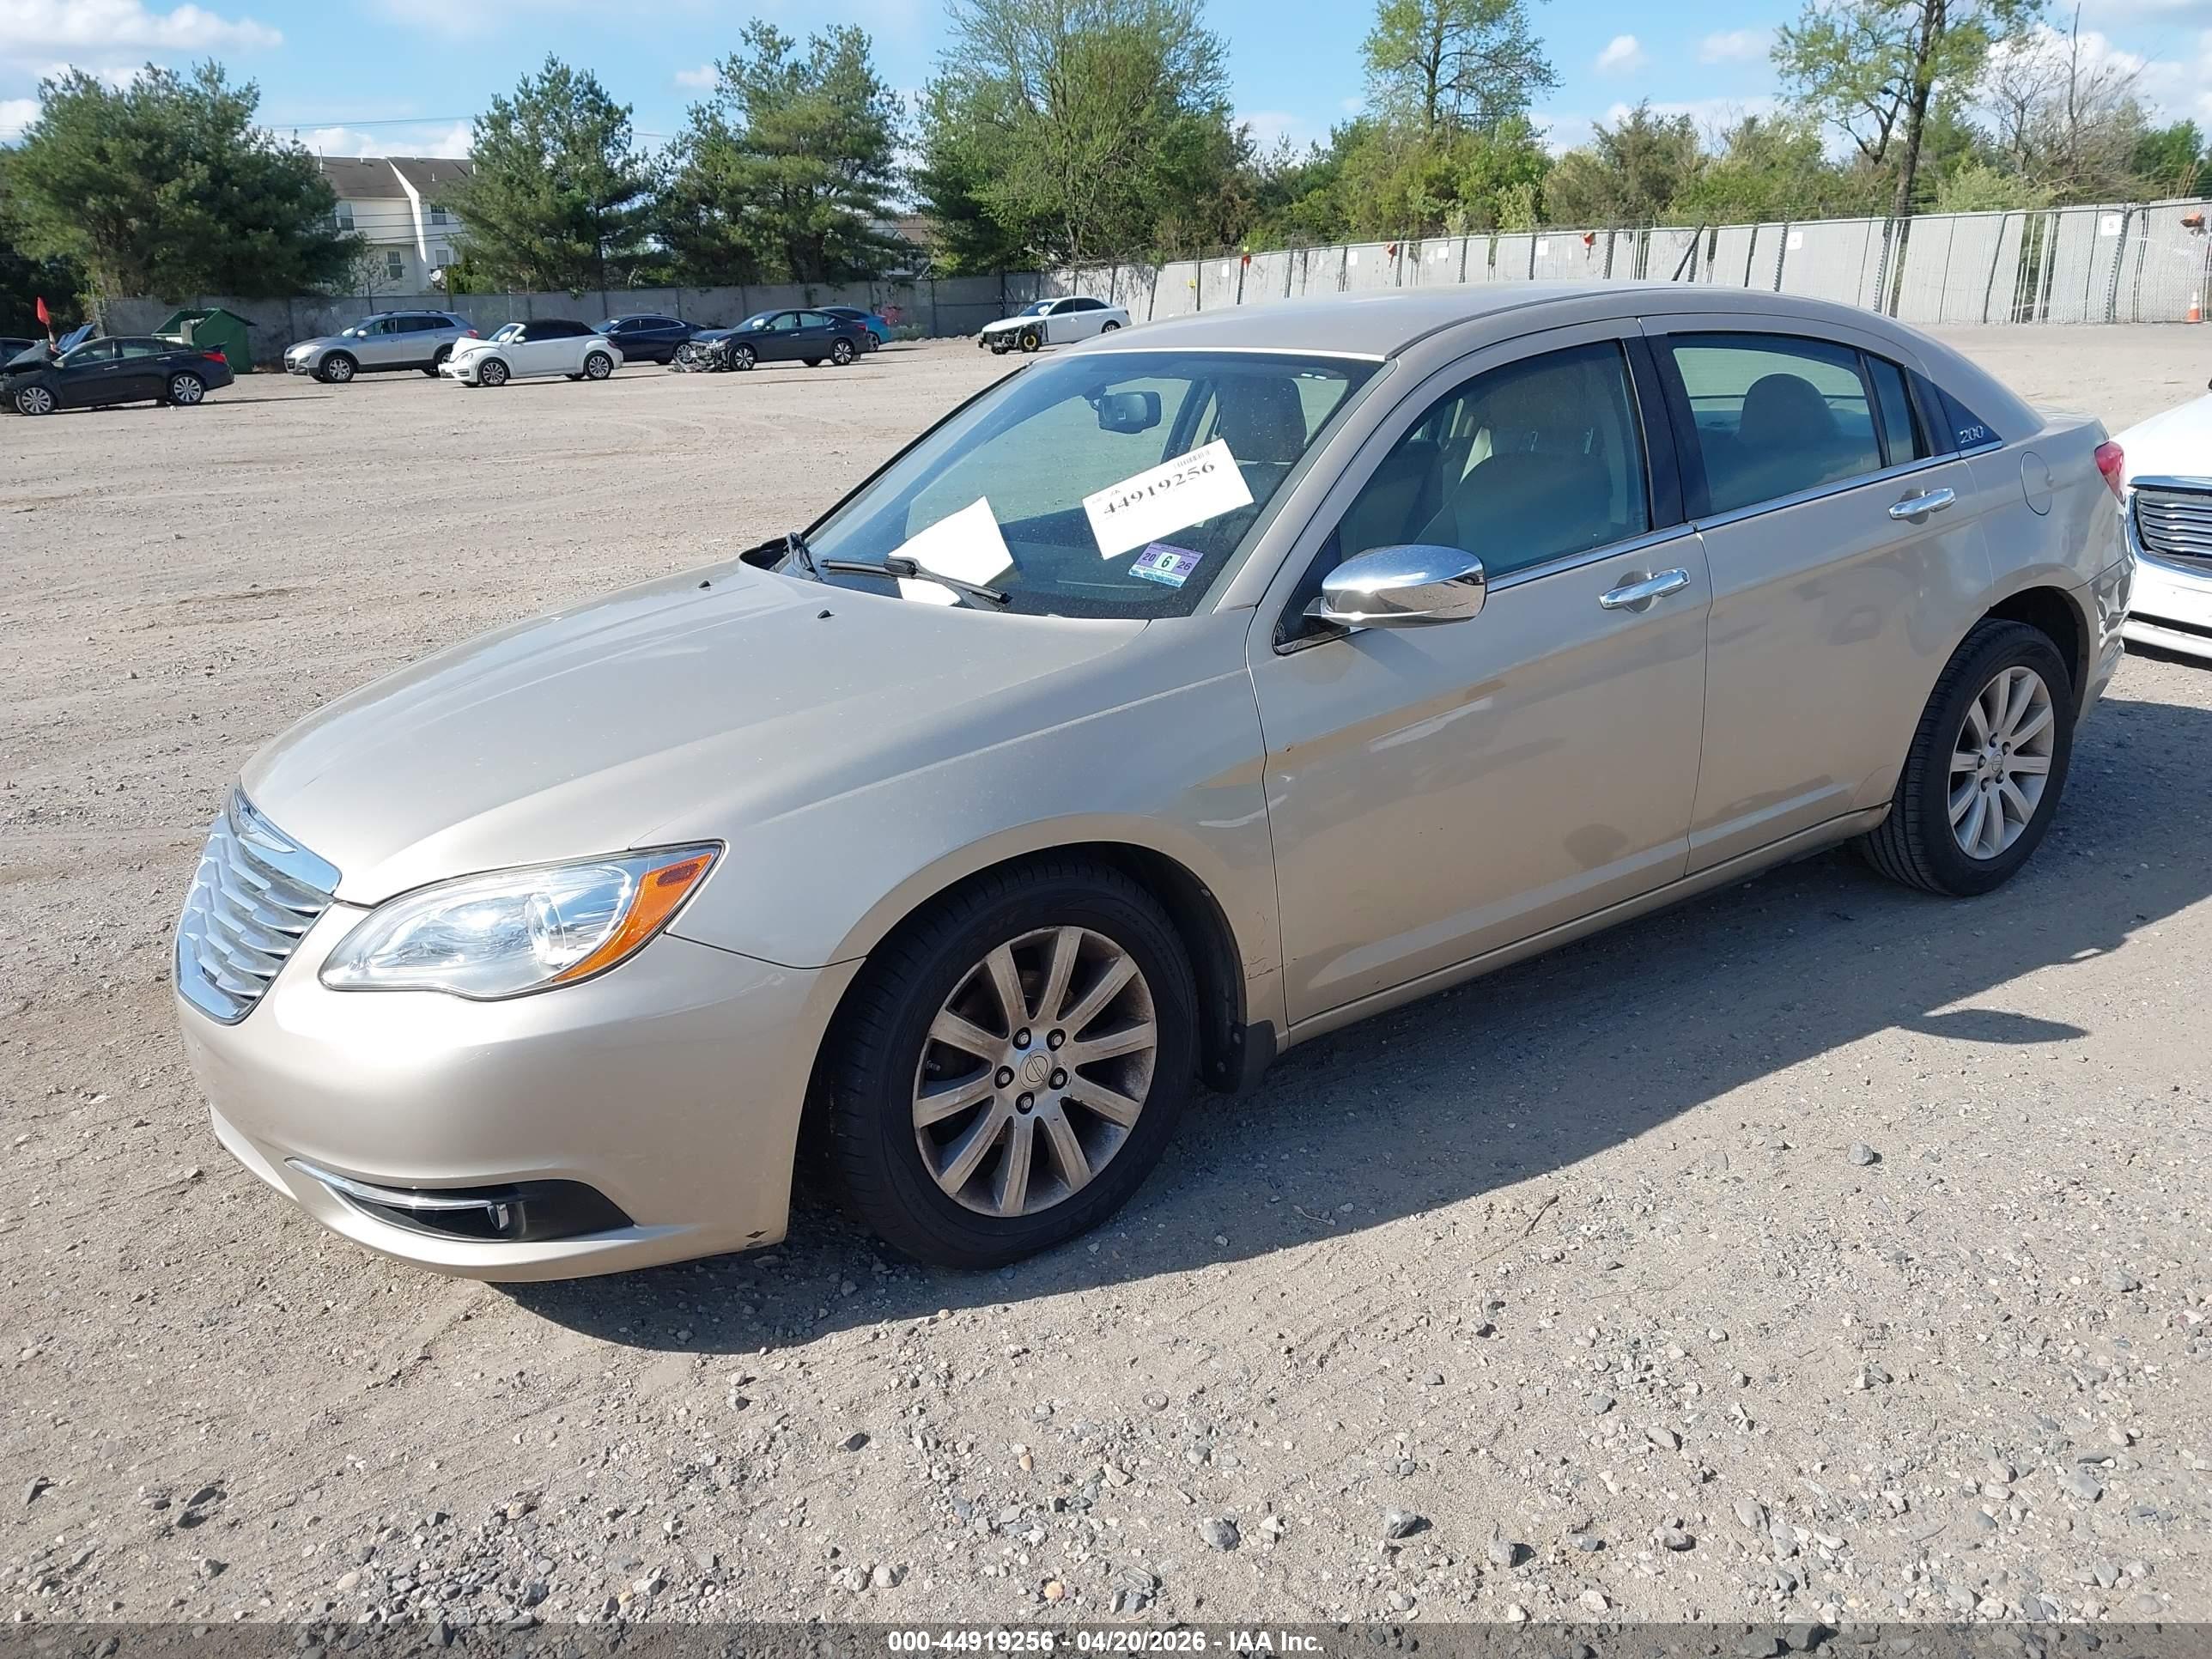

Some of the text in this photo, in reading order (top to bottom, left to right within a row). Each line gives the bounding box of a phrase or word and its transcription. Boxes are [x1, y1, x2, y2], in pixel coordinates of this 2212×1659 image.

[1959, 425, 1984, 444] 200
[1103, 459, 1215, 514] 44919256
[1142, 552, 1193, 571] 20 6 26
